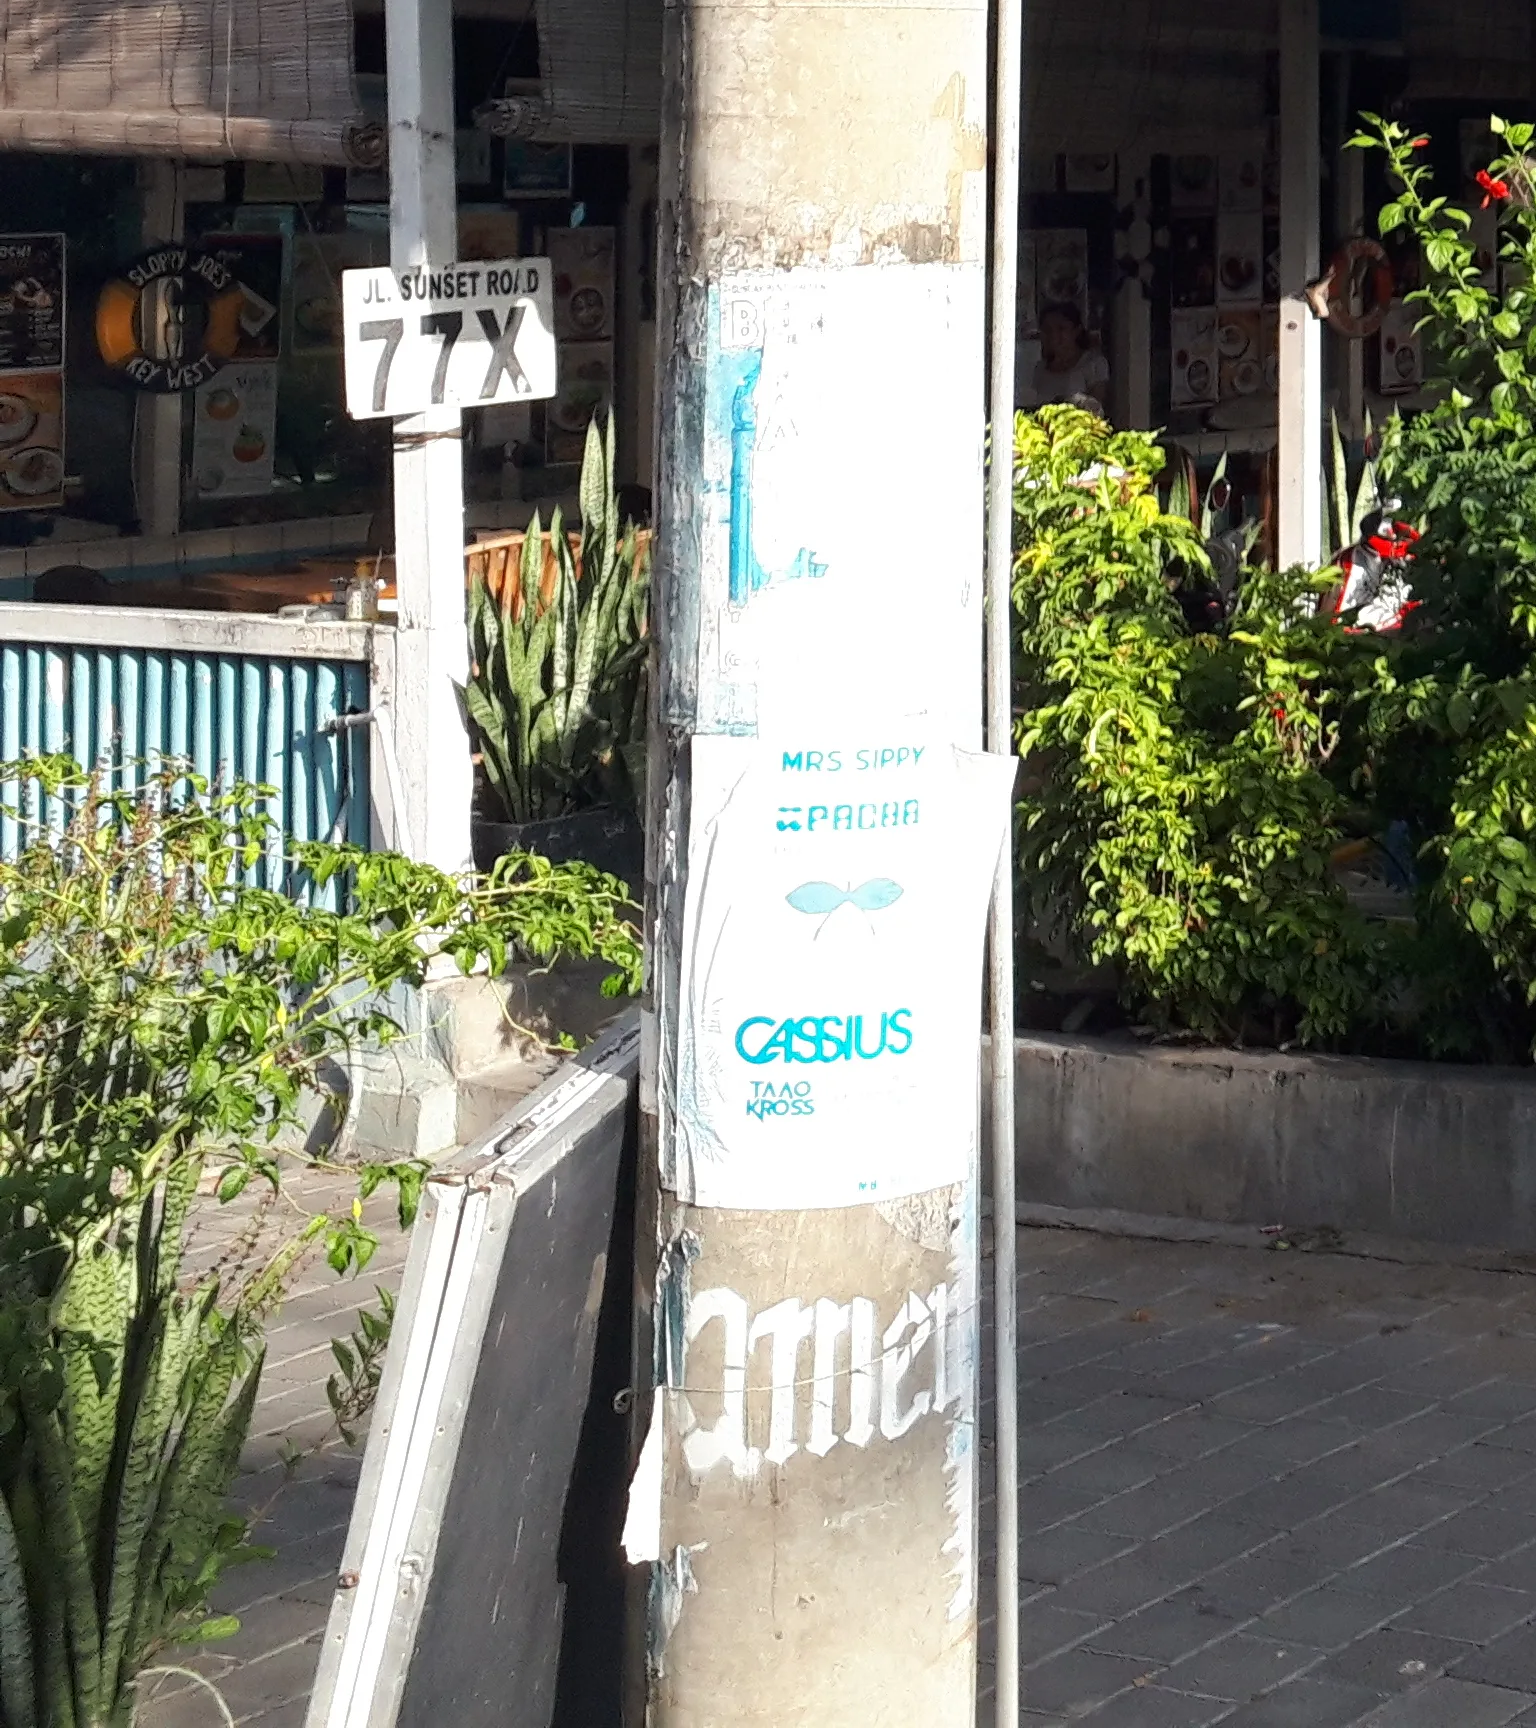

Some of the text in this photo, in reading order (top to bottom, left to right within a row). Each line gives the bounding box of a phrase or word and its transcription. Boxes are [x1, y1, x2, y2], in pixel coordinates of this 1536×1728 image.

[361, 278, 391, 305] JL.
[401, 270, 480, 302] SUNSET
[359, 306, 532, 413] 77X
[782, 745, 926, 772] MRS SIPPY
[734, 1007, 914, 1065] CASSIUS
[745, 1098, 815, 1122] KROSS
